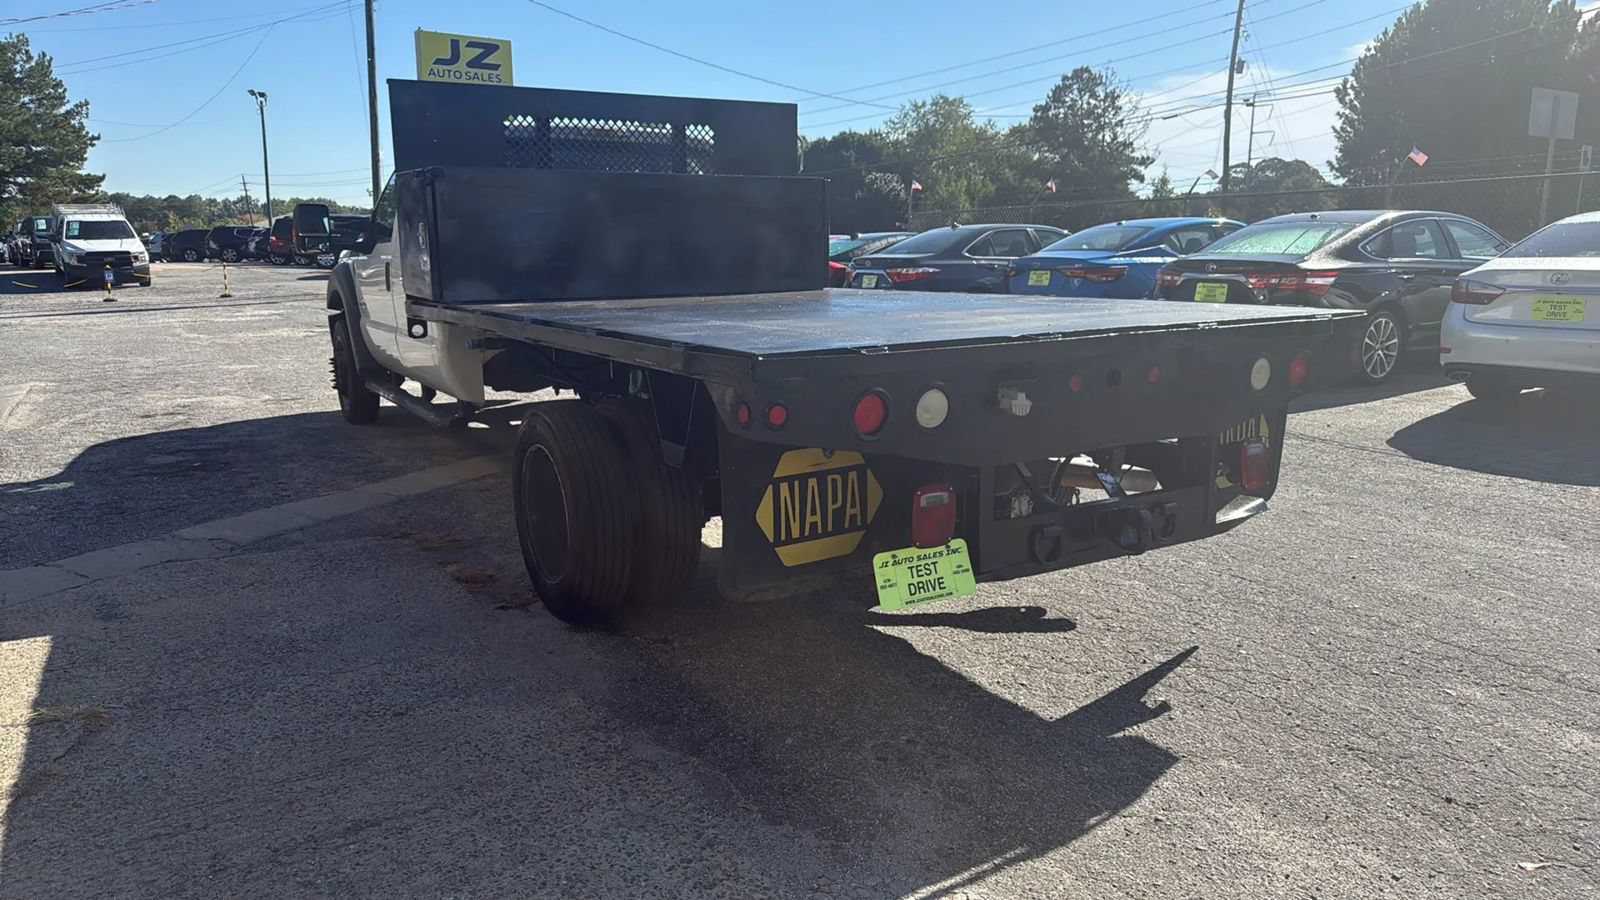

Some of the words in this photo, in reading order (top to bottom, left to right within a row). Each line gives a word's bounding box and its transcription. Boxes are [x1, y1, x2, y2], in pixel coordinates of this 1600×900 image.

[432, 38, 502, 71] JZ
[427, 67, 462, 80] AUTO
[464, 71, 503, 84] SALES
[779, 470, 862, 541] NAPA
[878, 560, 890, 569] JZ
[891, 556, 915, 567] AUTO
[916, 550, 944, 562] SALES
[907, 561, 939, 579] TEST
[907, 576, 946, 597] DRIVE
